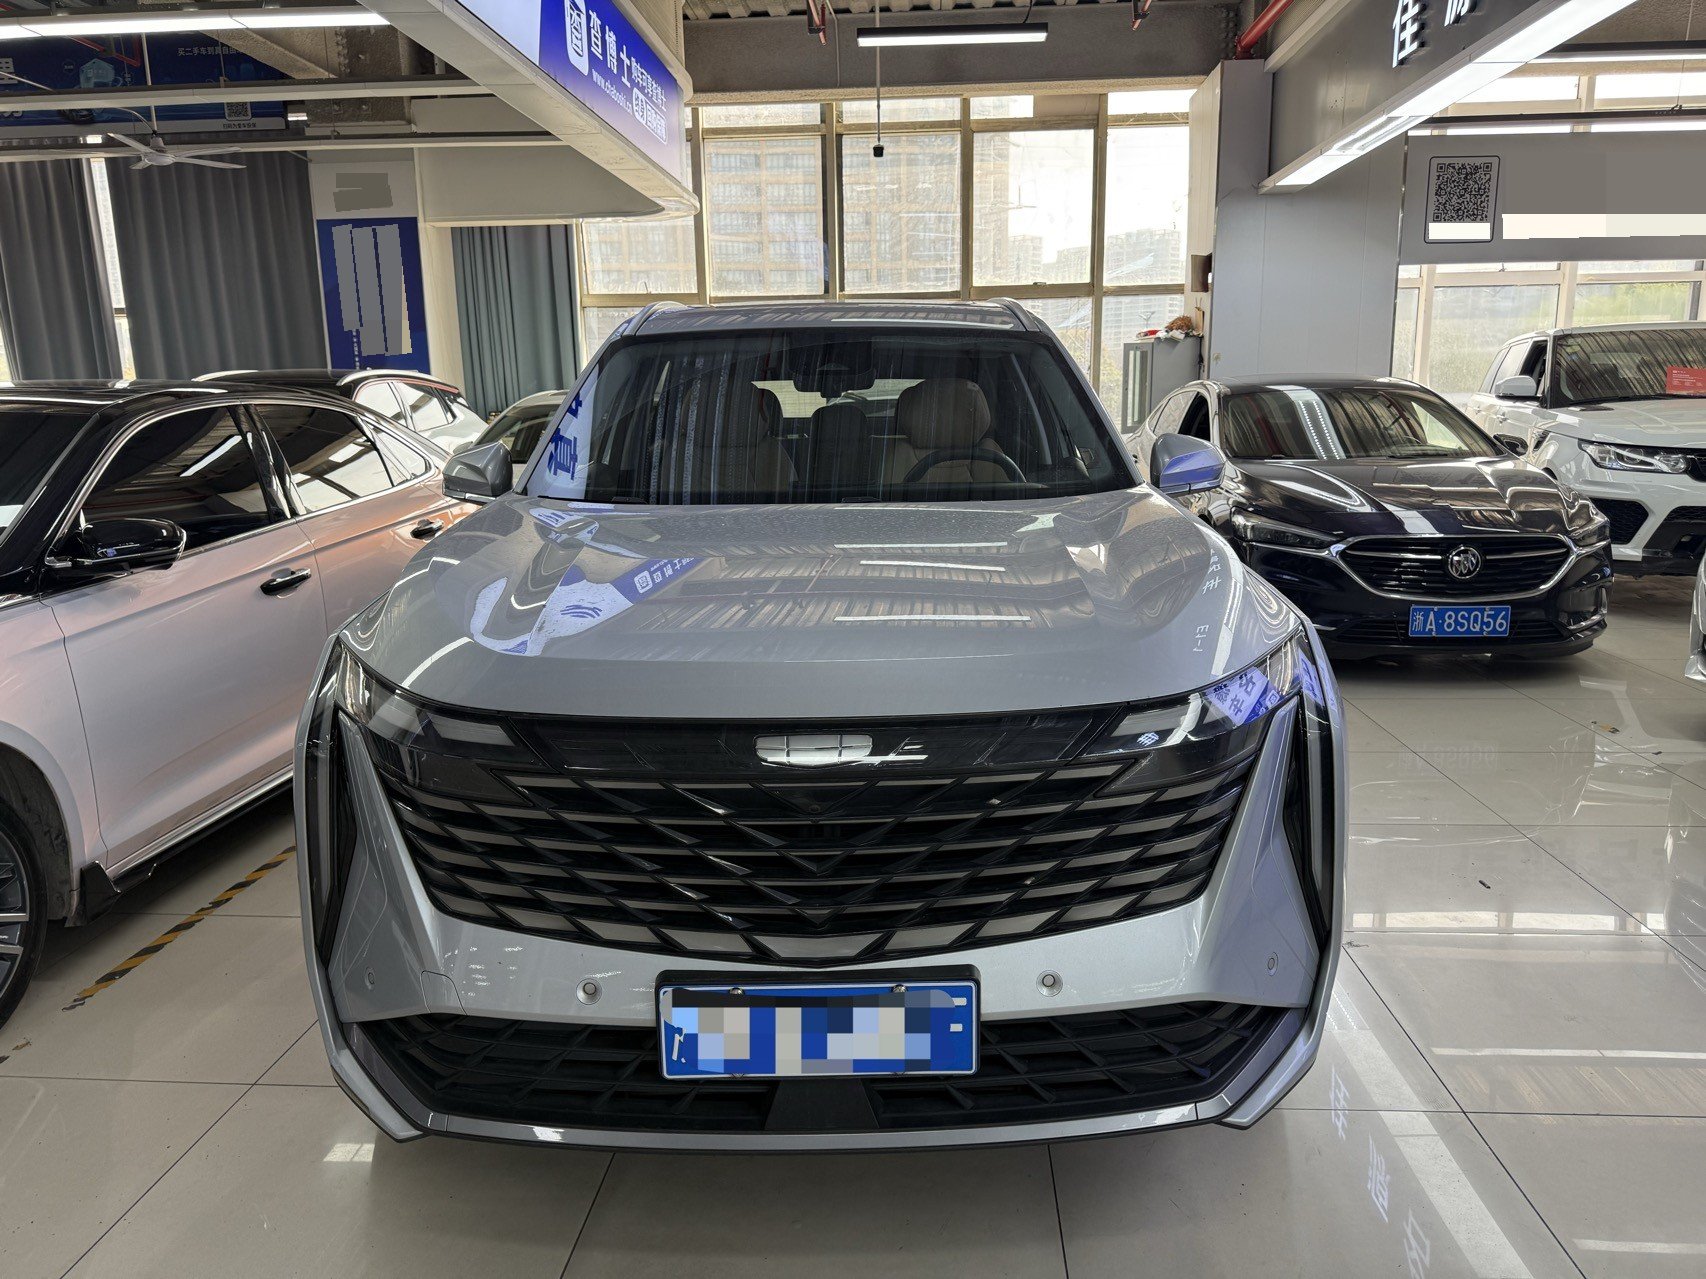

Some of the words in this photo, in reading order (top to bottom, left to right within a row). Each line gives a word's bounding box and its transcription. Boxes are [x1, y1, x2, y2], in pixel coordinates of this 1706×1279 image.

[177, 46, 240, 56] 买二手车到真自由
[589, 10, 631, 88] 查博士
[1412, 610, 1507, 632] 浙A·8SQ56
